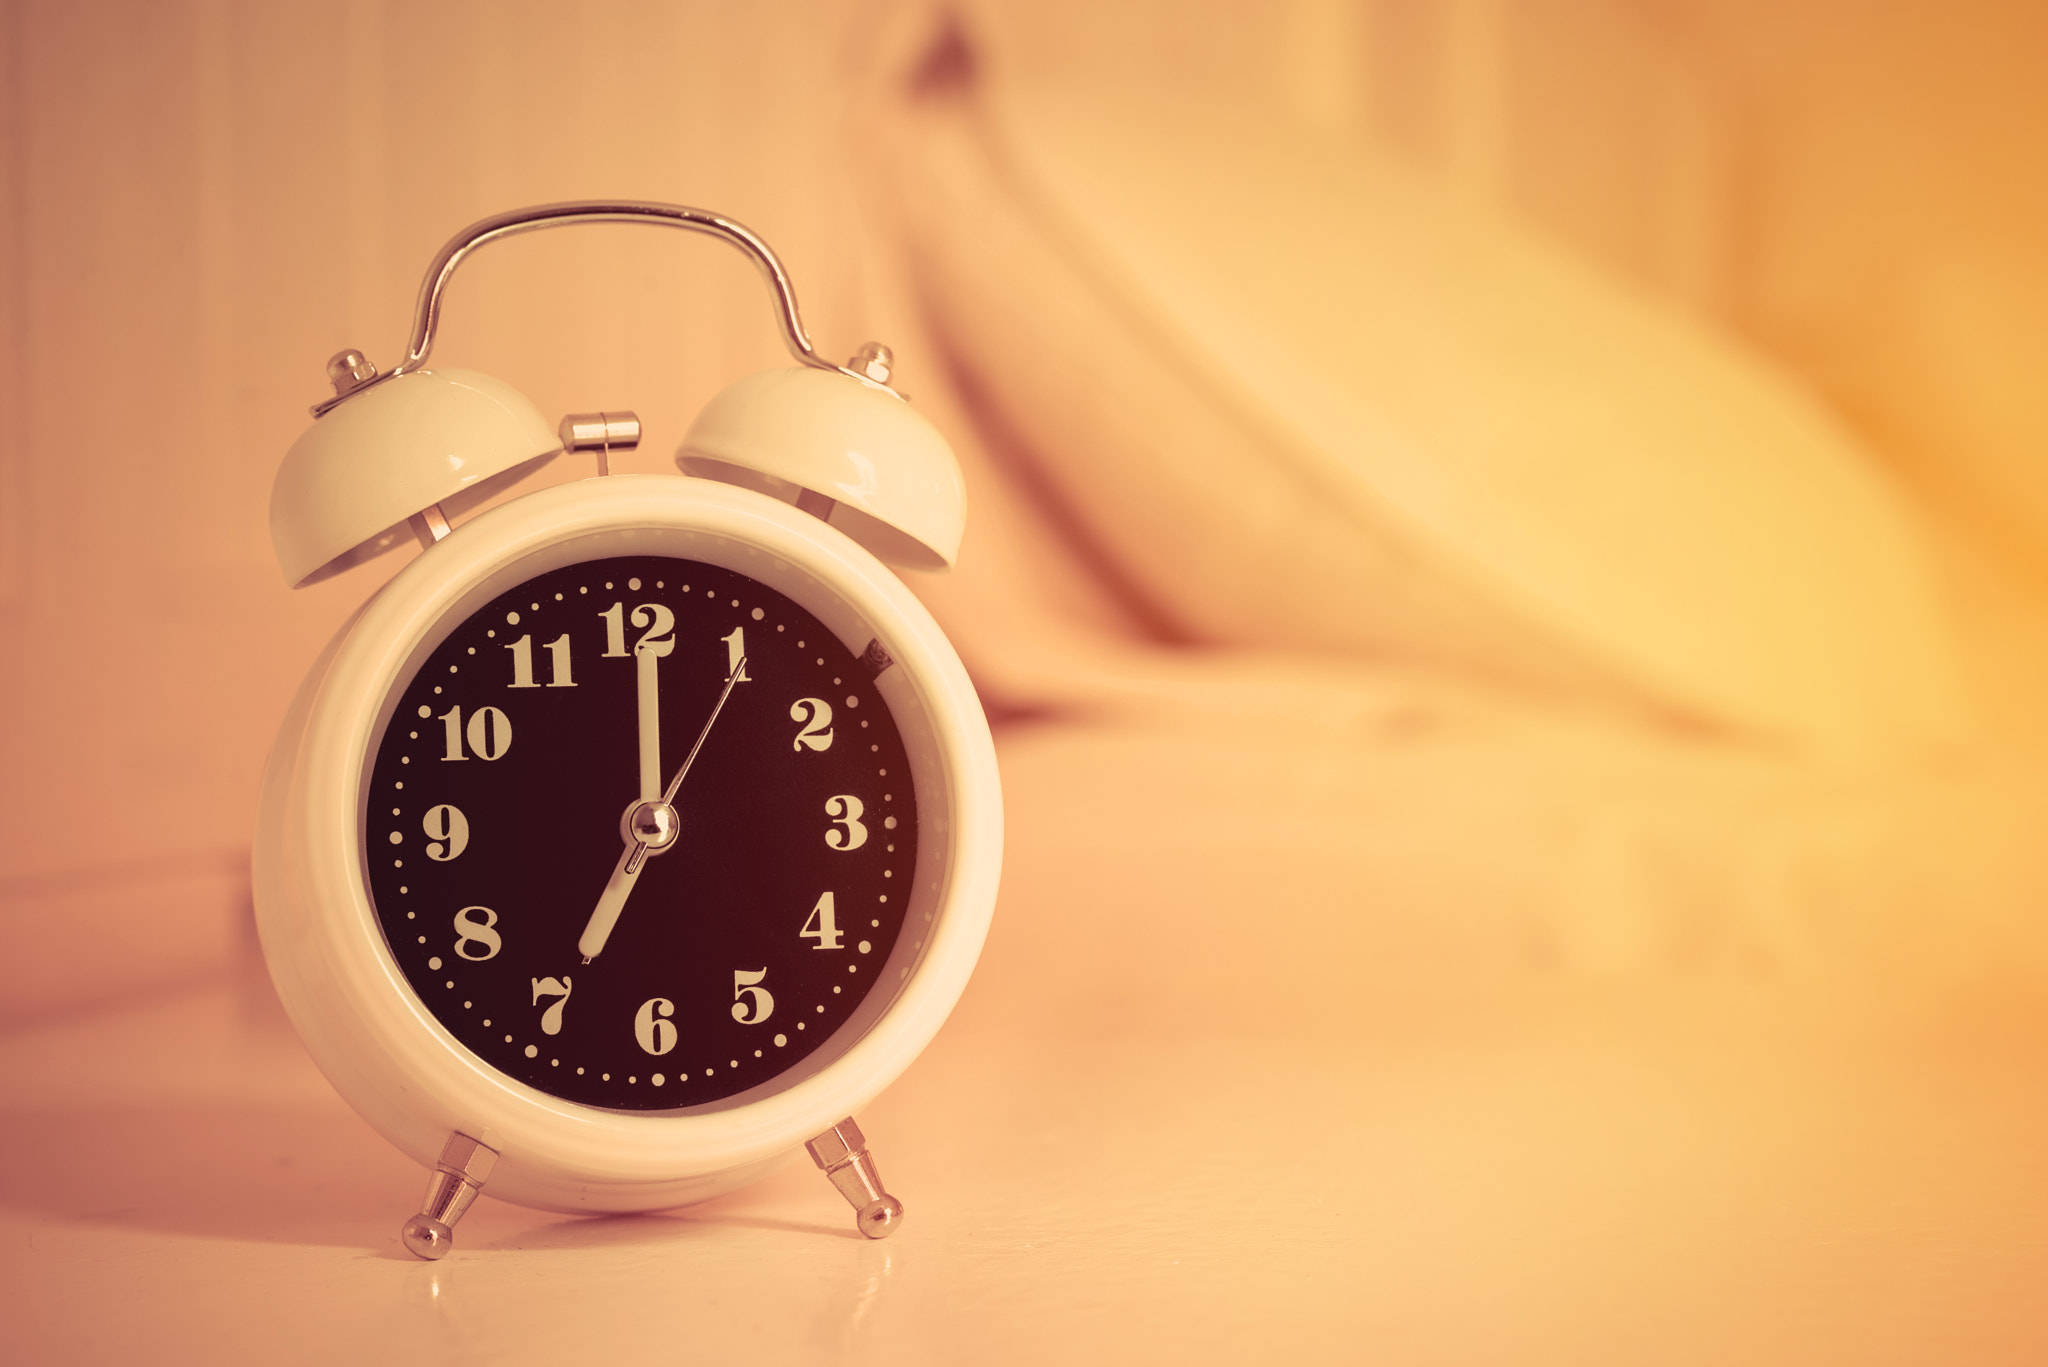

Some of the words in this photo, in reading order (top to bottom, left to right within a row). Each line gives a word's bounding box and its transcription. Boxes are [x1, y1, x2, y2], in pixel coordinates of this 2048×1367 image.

[598, 602, 676, 658] 12
[720, 627, 752, 682] 1
[504, 634, 578, 688] 11
[437, 705, 513, 761] 10
[790, 698, 834, 752] 2
[422, 804, 470, 862] 9
[825, 795, 868, 852] 3
[453, 906, 502, 962] 8
[800, 891, 845, 950] 4
[531, 976, 572, 1036] 7
[731, 967, 775, 1025] 5
[635, 998, 678, 1056] 6
